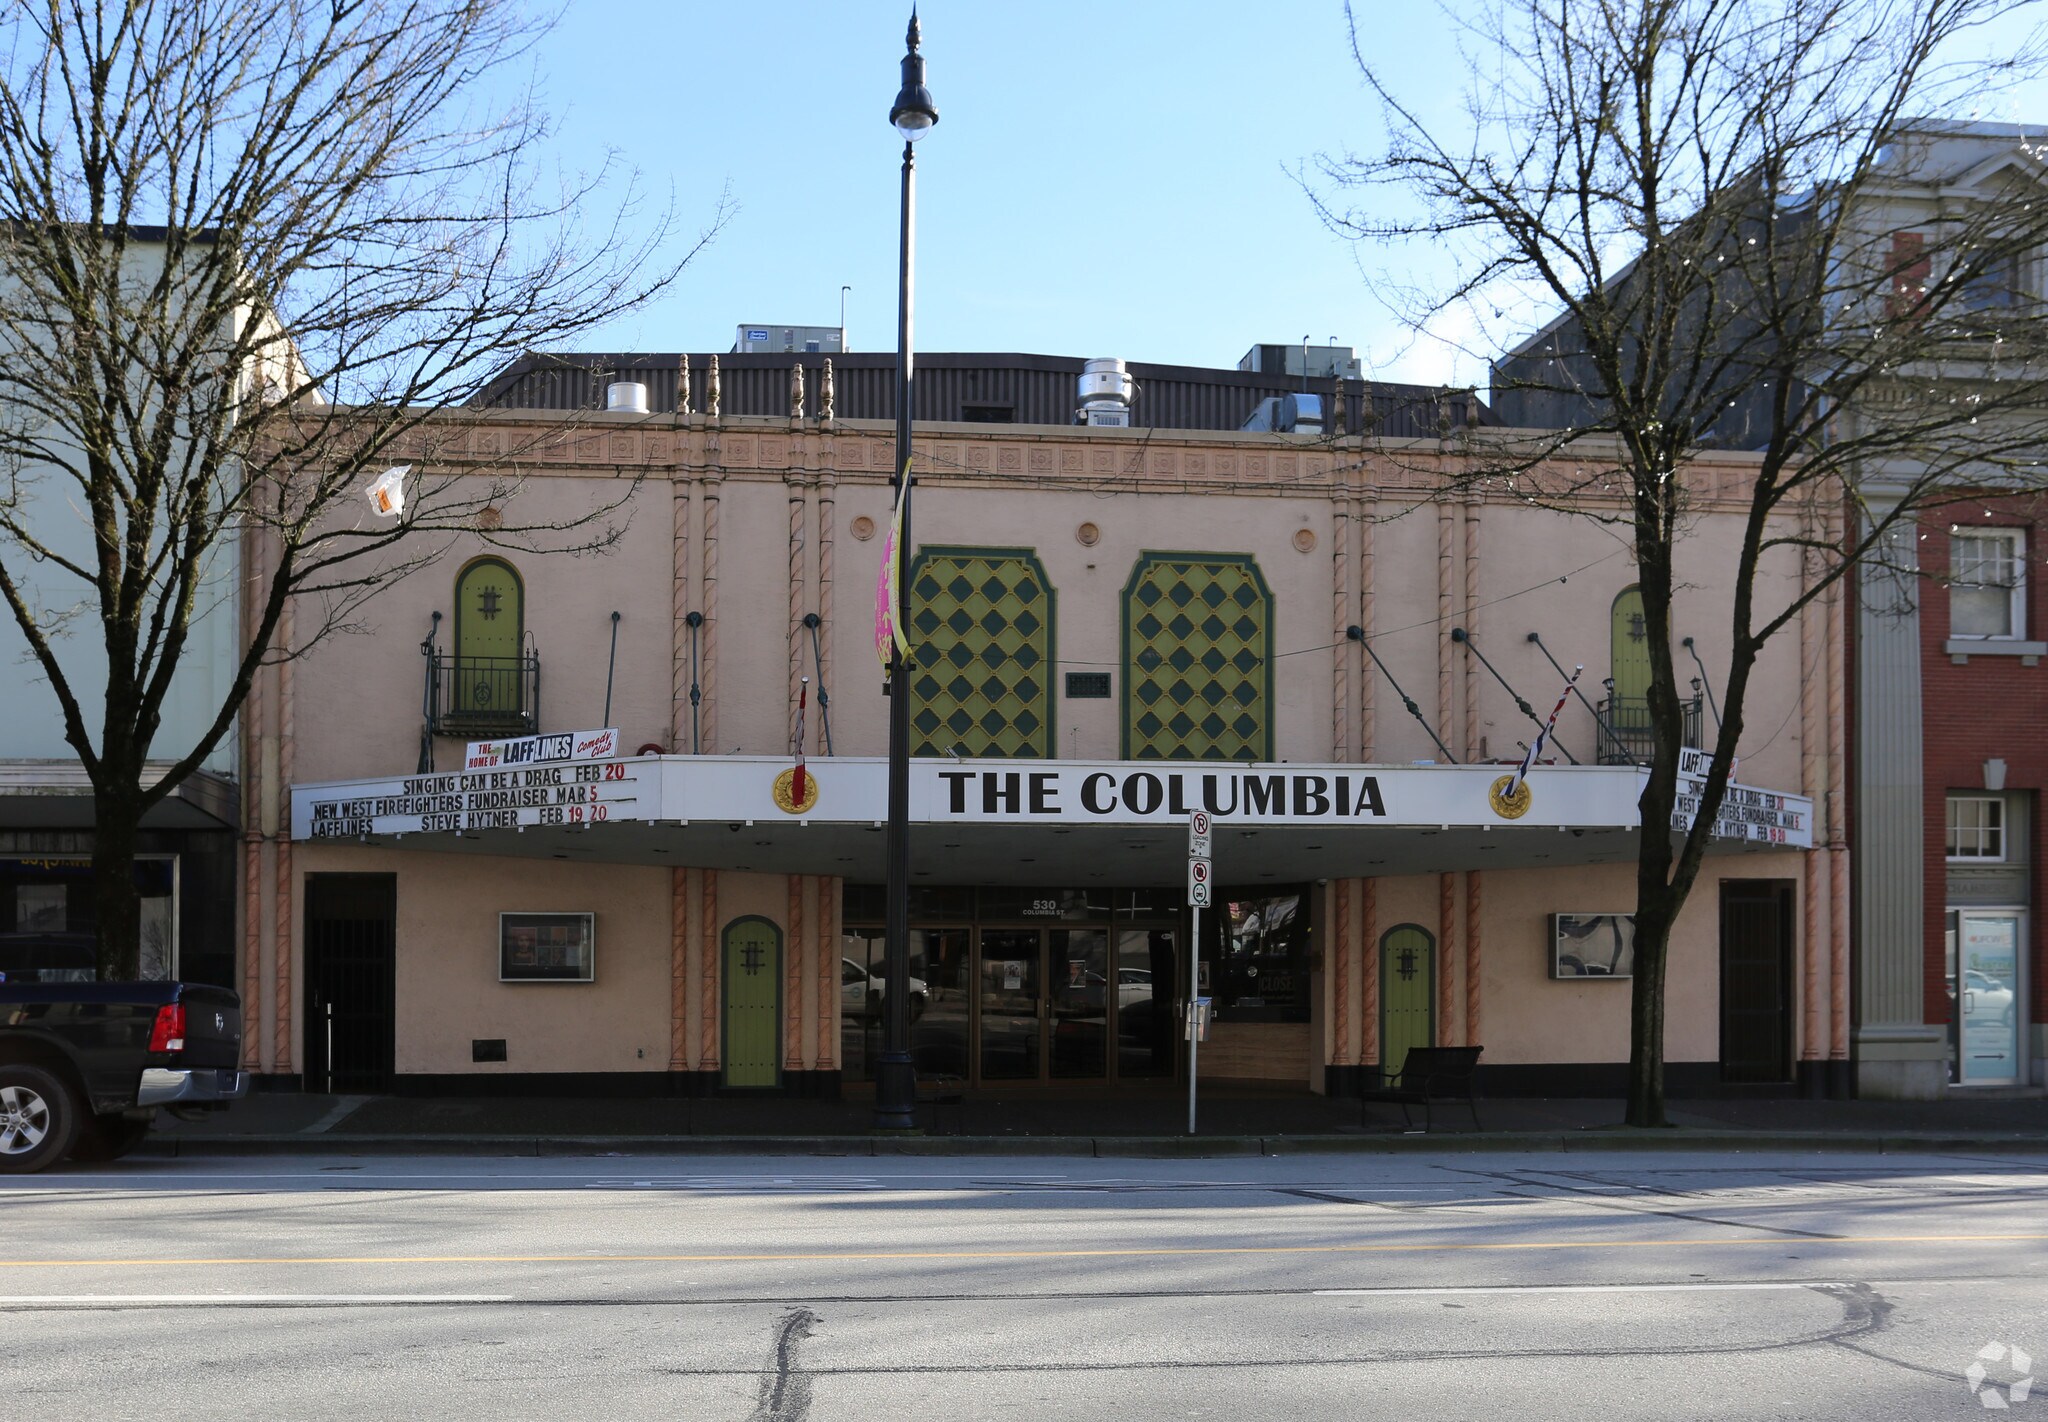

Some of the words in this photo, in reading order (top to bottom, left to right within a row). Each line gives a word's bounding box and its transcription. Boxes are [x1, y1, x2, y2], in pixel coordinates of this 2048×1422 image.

[479, 743, 491, 755] THE
[576, 731, 612, 753] Comedy
[591, 740, 612, 758] Club
[468, 757, 488, 769] HOME
[489, 756, 498, 767] OF
[403, 776, 455, 795] SINGING
[460, 773, 486, 791] CAN
[491, 772, 507, 788] BE
[511, 771, 520, 787] A
[525, 768, 561, 786] DRAG
[575, 765, 600, 783] FEB
[605, 763, 625, 780] 20
[314, 803, 338, 820] NEW
[341, 801, 372, 817] WEST
[376, 793, 463, 816] FIREFIGHTERS
[468, 788, 548, 809] FUNDRAISER
[557, 786, 586, 804] MAR
[590, 785, 598, 802] 5
[938, 772, 1062, 814] THE
[1080, 772, 1386, 816] COLUMBIA
[311, 819, 373, 837] LAFFLINES
[421, 814, 460, 831] STEVE
[467, 810, 518, 828] HYTNER
[540, 807, 563, 824] FEB
[568, 806, 583, 823] 19
[590, 805, 607, 822] 20
[1033, 900, 1056, 910] 530
